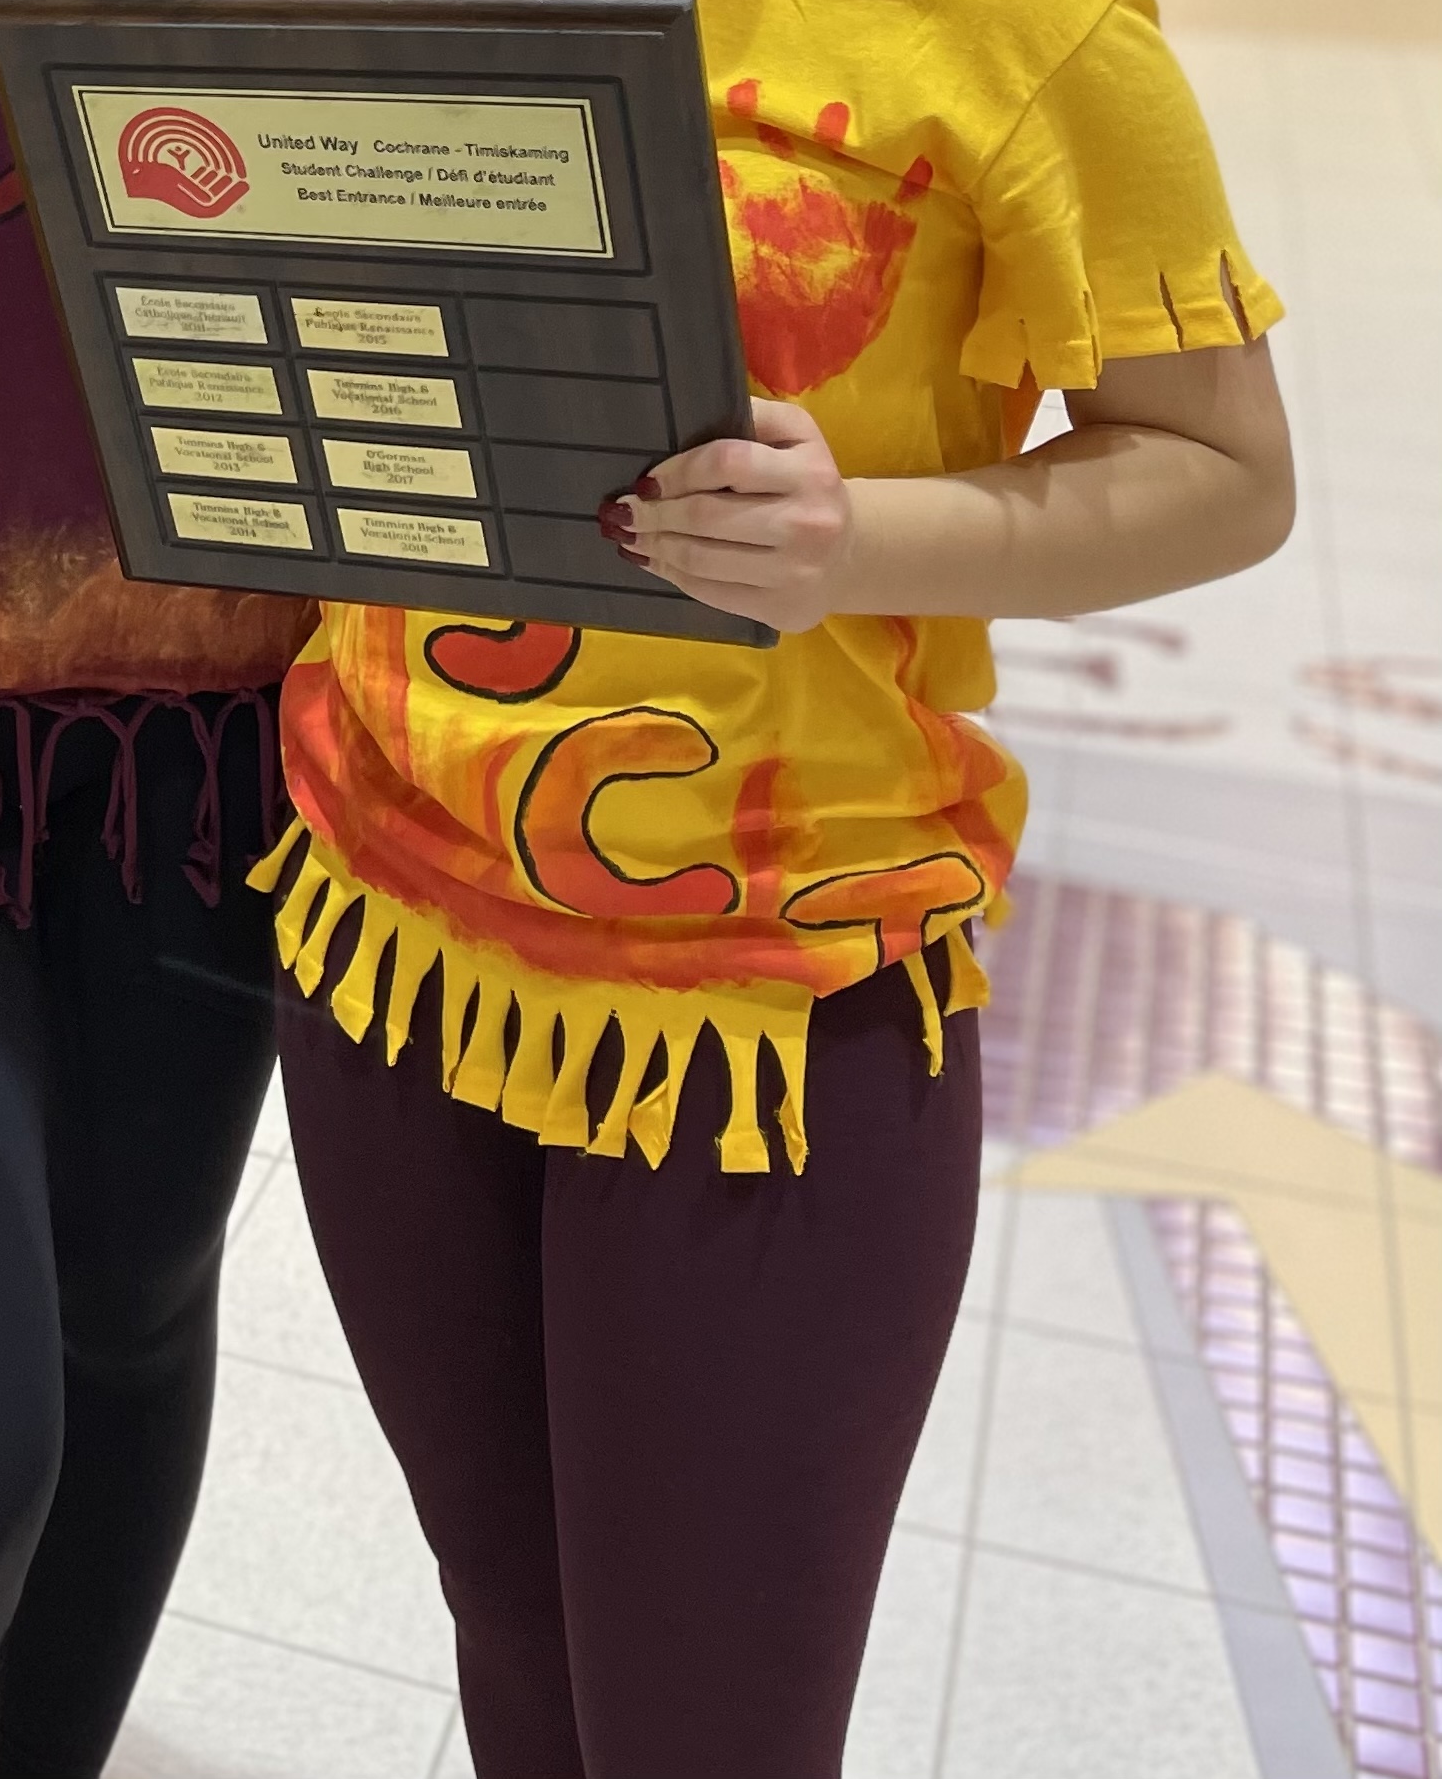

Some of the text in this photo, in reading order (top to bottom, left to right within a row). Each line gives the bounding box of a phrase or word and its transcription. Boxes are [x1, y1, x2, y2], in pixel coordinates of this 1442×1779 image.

[257, 133, 315, 151] United
[321, 135, 358, 155] Way
[373, 140, 450, 156] Cochrane
[464, 143, 570, 163] Timiskaming
[281, 162, 342, 178] Student
[345, 164, 423, 183] Challenge
[437, 168, 469, 183] Défi
[473, 170, 556, 187] d'étudiant
[297, 187, 333, 202] Best
[337, 190, 407, 206] Entrance
[419, 193, 492, 210] Meilleure
[496, 197, 548, 212] entrée
[354, 309, 422, 323] Secondaire
[305, 318, 435, 336] Publique Renaissance
[191, 369, 253, 382] Secondaire
[149, 378, 194, 391] Publique
[334, 378, 430, 394] Timmins High &
[194, 392, 223, 403] 2012
[331, 389, 437, 407] Vocational School
[372, 404, 402, 415] 2016
[176, 436, 224, 449] Timmins
[227, 440, 252, 453] High
[174, 447, 273, 464] Vocational School
[213, 461, 241, 472] 2013
[363, 460, 434, 476] High School
[386, 473, 415, 485] 2017
[193, 501, 240, 514] Timmins
[243, 506, 269, 518] High
[191, 512, 290, 529] Vocational School
[363, 517, 415, 531] Timmins
[417, 522, 445, 534] High
[229, 525, 257, 538] 2014
[360, 527, 465, 546] Vocational School
[401, 542, 429, 554] 2018
